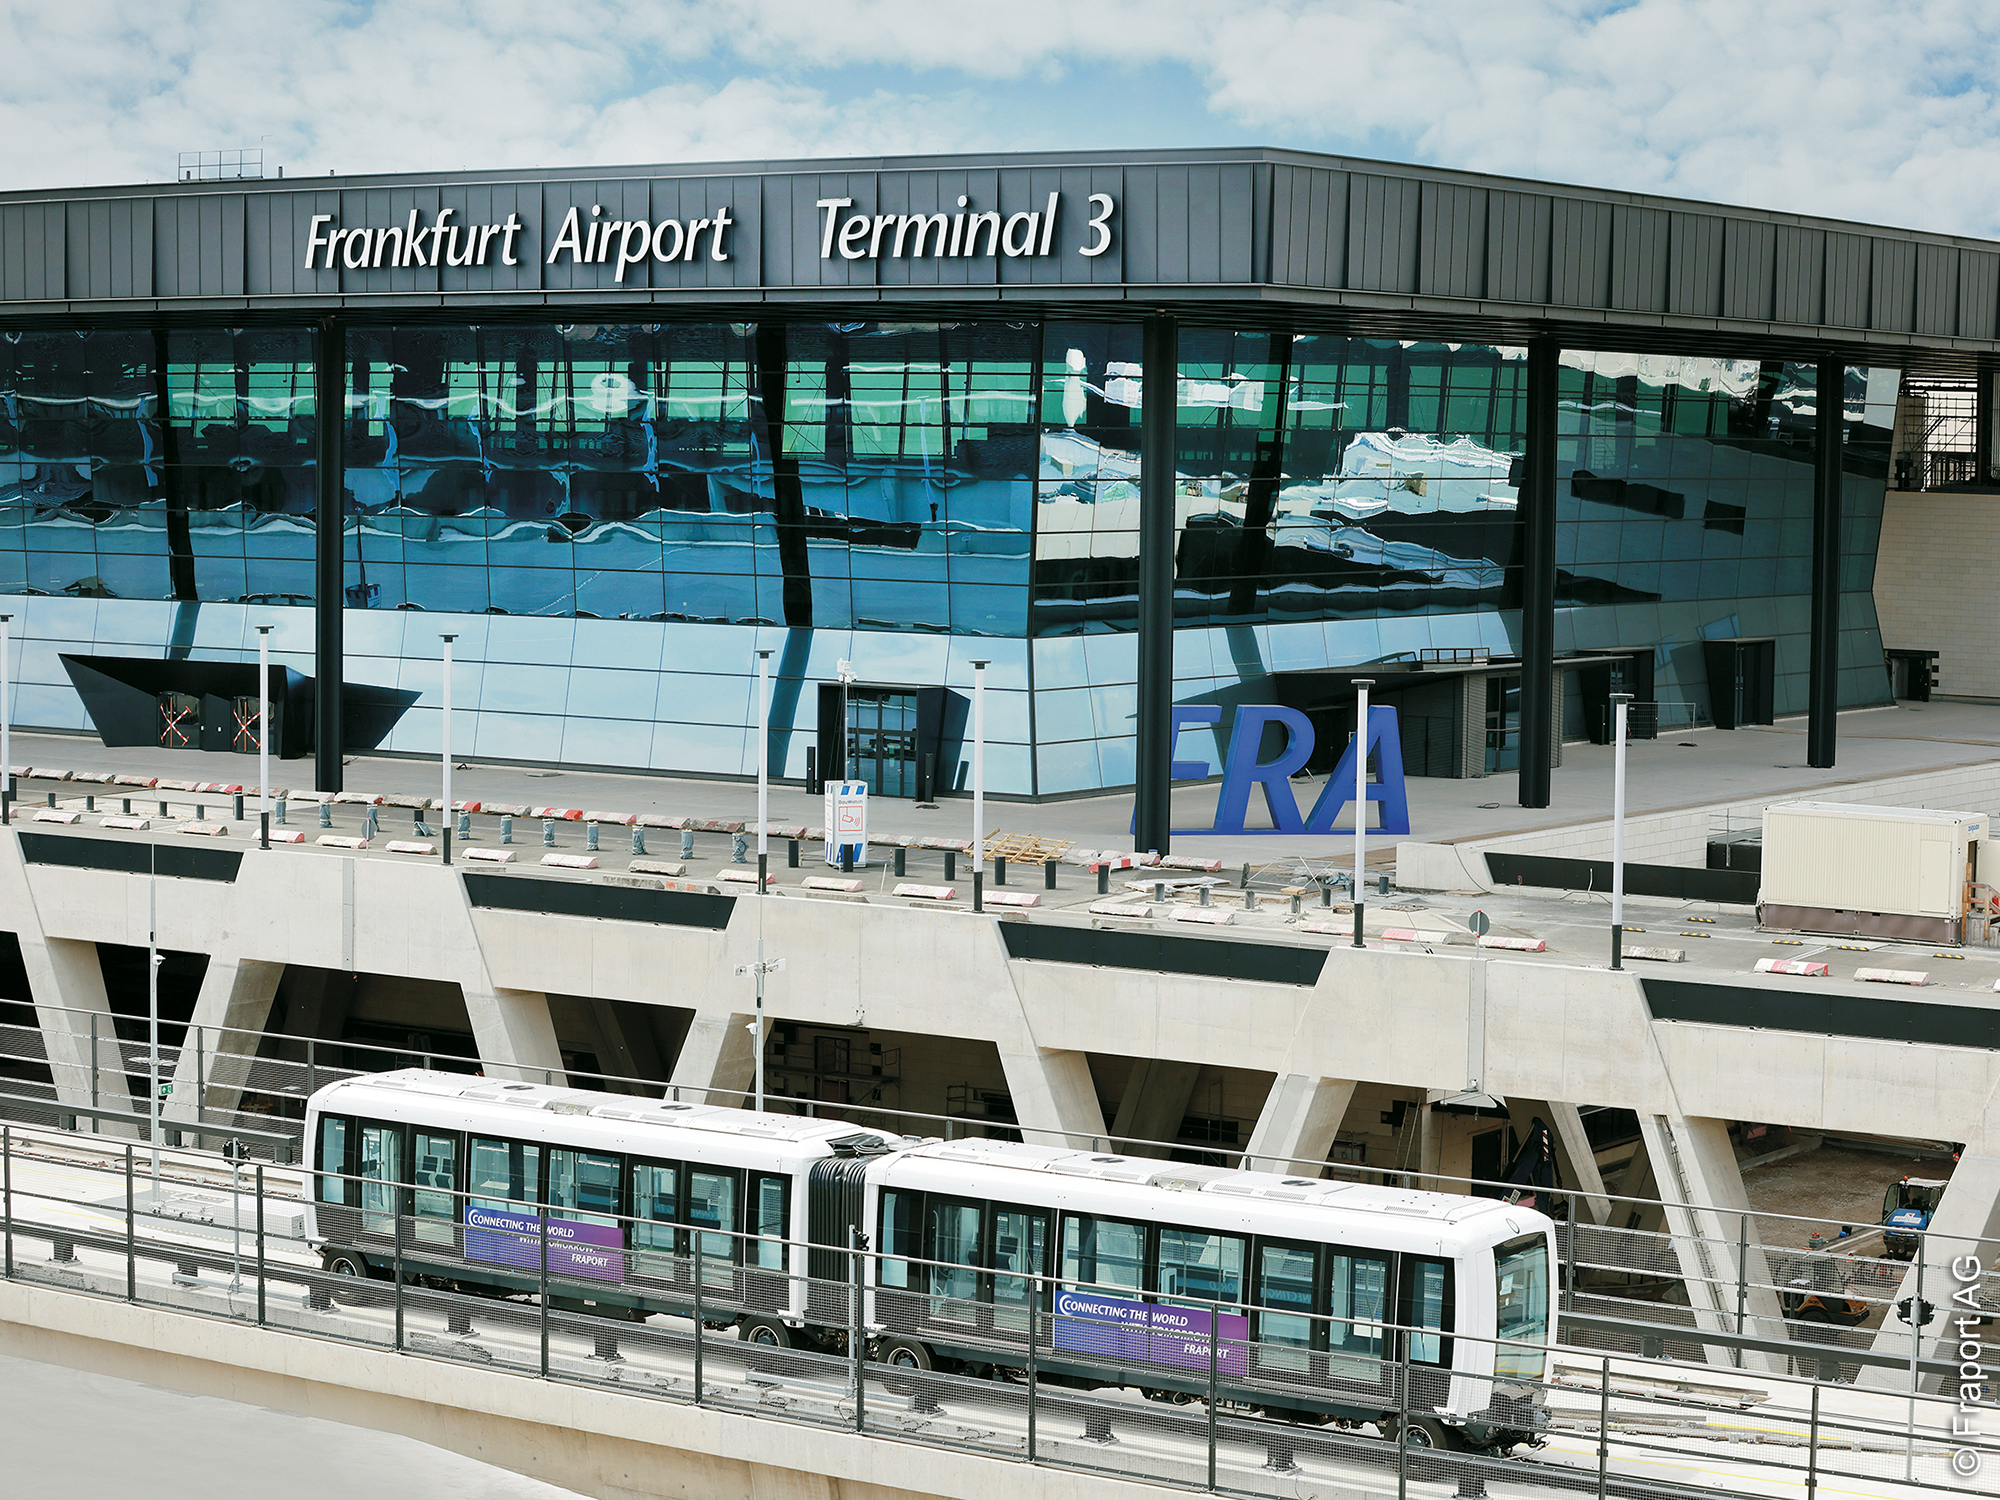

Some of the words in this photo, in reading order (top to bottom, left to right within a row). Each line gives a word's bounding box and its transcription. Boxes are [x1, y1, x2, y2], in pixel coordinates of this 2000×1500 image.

[305, 208, 523, 270] Frankfurt
[546, 204, 735, 283] Airport
[816, 191, 1060, 260] Terminal
[1078, 193, 1115, 257] 3
[470, 1211, 524, 1231] CONNECTING
[526, 1221, 541, 1234] THE
[546, 1225, 574, 1238] WORLD
[571, 1253, 609, 1268] FRAPORT
[1062, 1297, 1127, 1319] CONNECTING
[1129, 1309, 1148, 1321] THE
[1152, 1312, 1188, 1327] WORLD
[1184, 1343, 1229, 1359] FRAPRT
